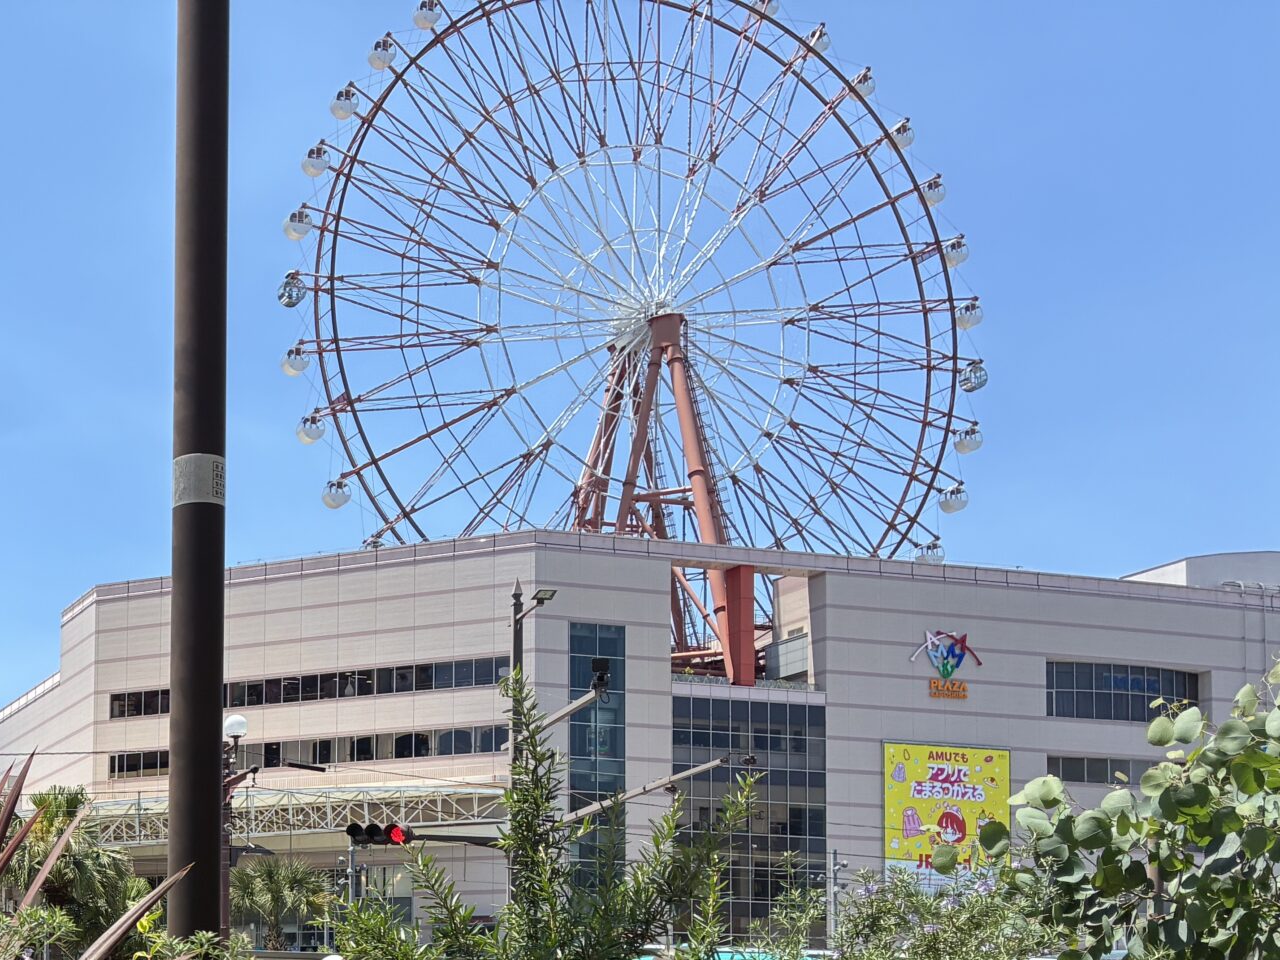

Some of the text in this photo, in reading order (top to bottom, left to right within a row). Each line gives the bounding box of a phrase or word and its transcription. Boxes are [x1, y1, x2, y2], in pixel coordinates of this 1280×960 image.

[929, 678, 969, 691] PLAZA
[927, 750, 969, 764] AMUでも
[926, 762, 970, 782] アプリで
[910, 780, 986, 802] たまるつかえる
